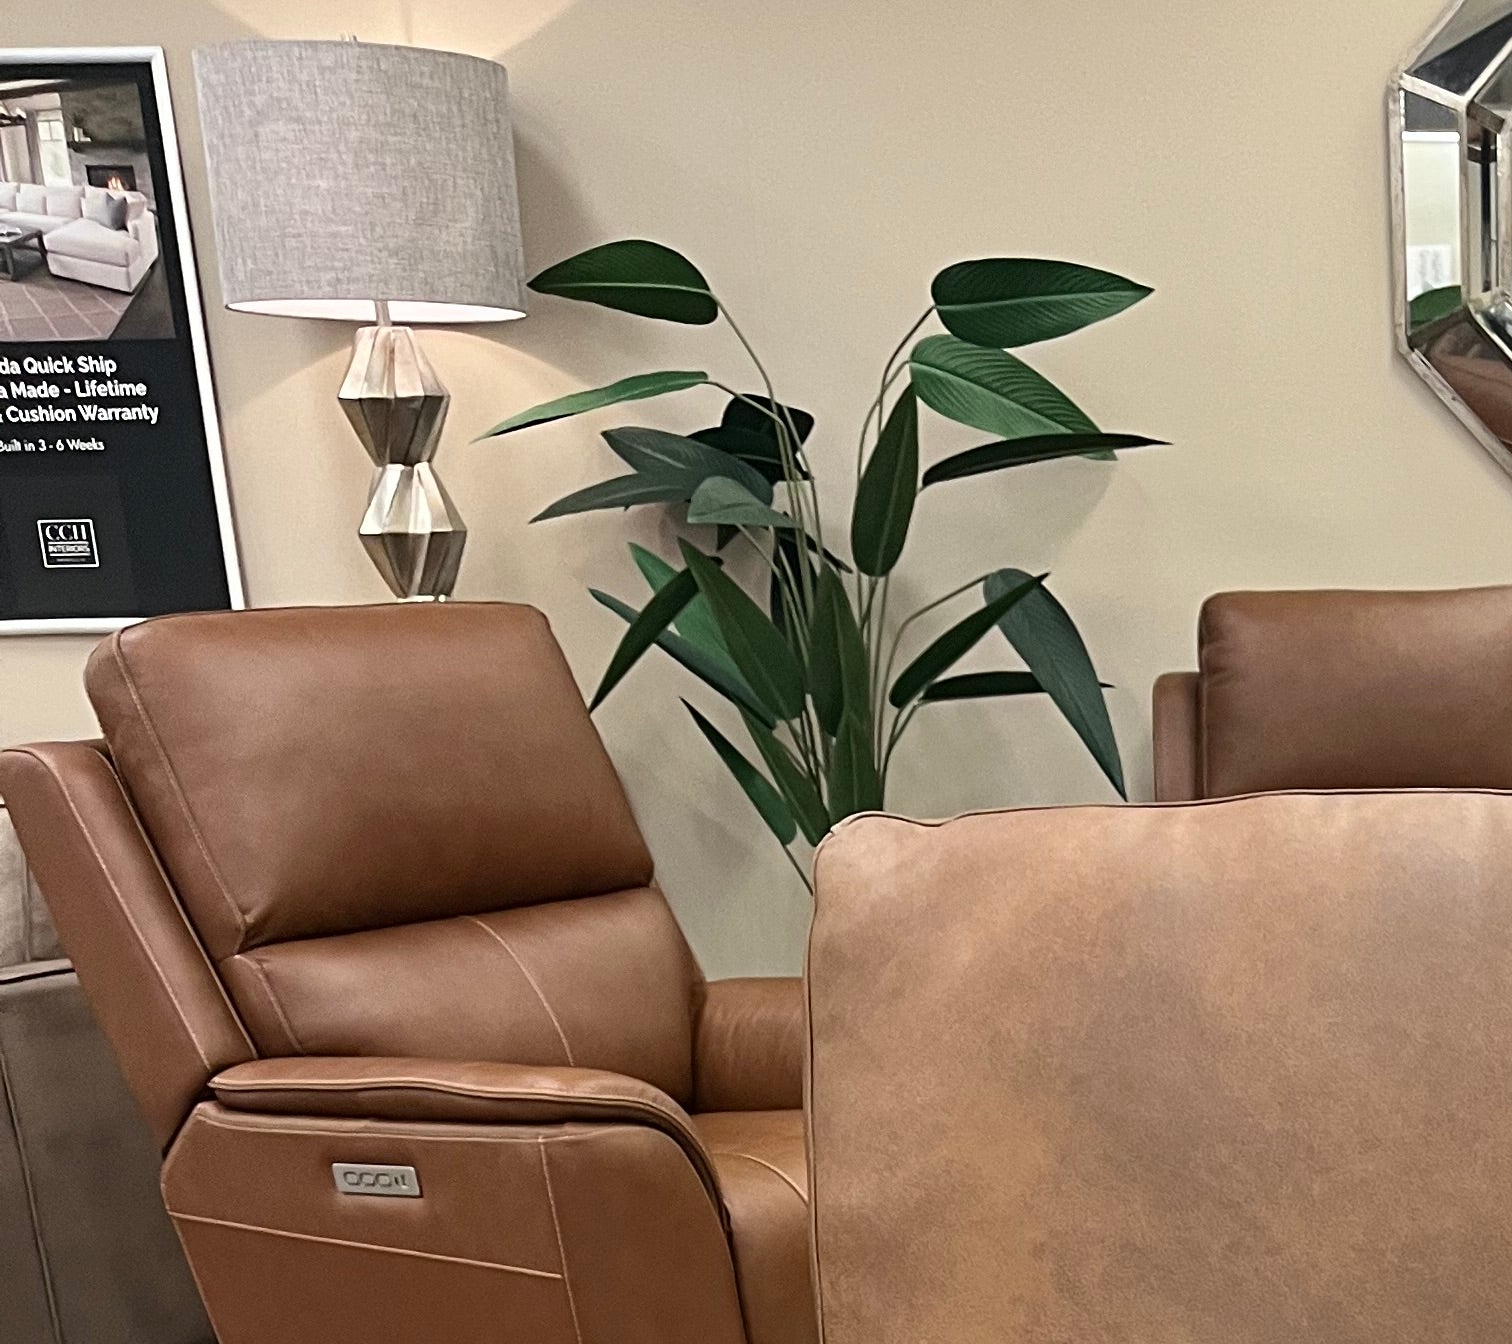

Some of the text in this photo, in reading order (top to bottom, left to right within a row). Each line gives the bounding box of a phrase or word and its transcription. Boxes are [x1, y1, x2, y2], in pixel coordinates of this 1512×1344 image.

[23, 356, 75, 374] Quick
[76, 355, 117, 377] Ship
[10, 380, 60, 398] Made
[74, 379, 147, 397] Lifetime
[5, 405, 77, 423] Cushion
[77, 403, 159, 425] Warranty
[38, 439, 47, 451] 3
[55, 439, 65, 451] 6
[66, 437, 105, 450] Weeks
